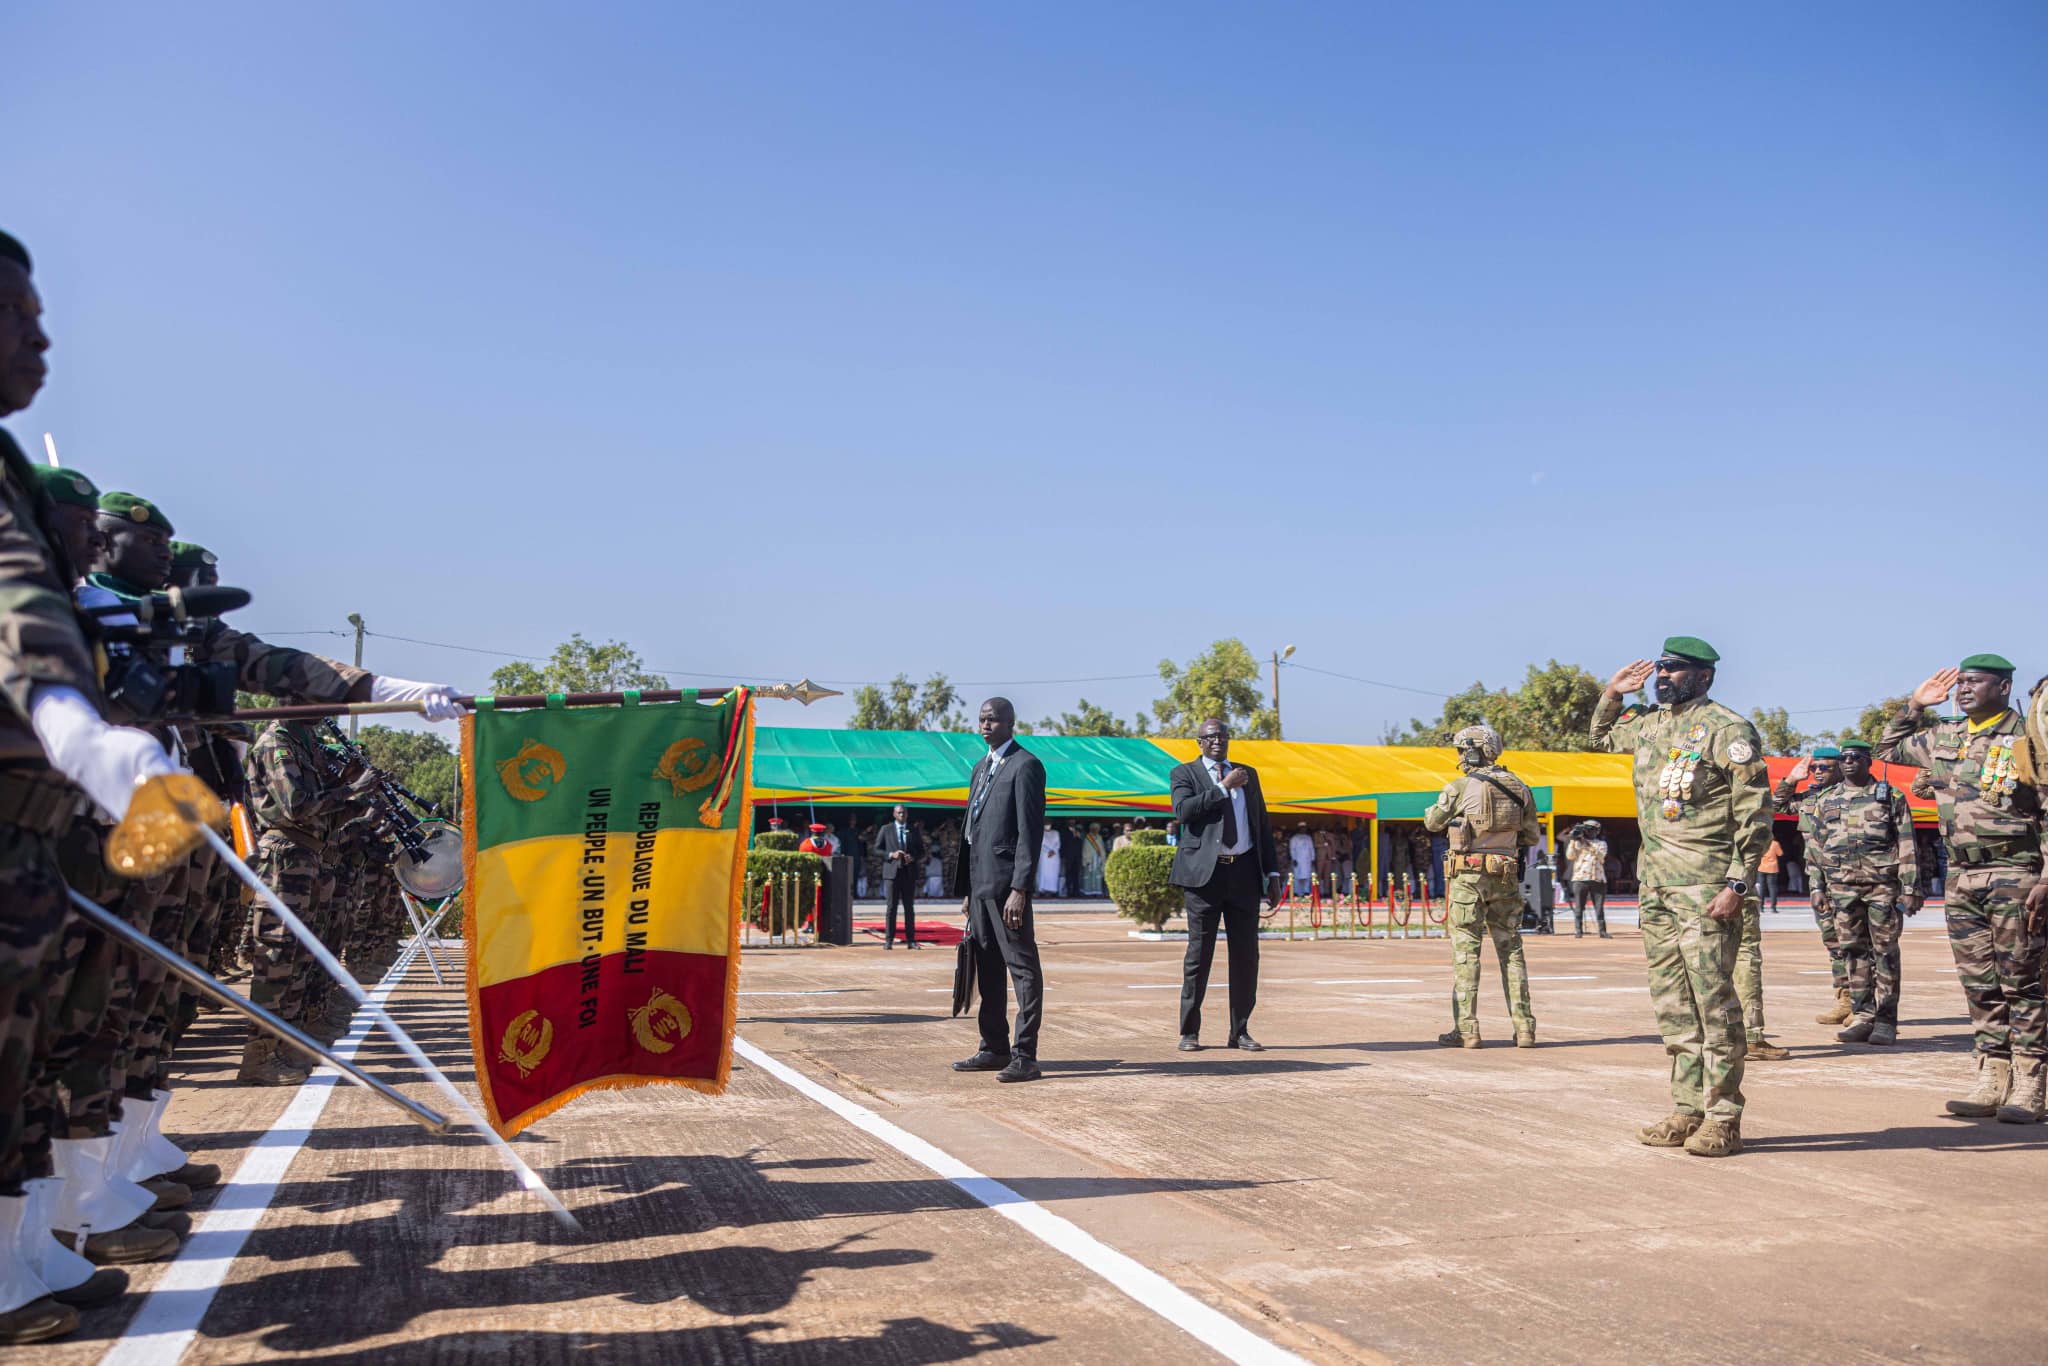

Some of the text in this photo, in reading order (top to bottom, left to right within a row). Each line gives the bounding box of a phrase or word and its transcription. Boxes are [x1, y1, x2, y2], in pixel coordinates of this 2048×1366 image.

[588, 788, 612, 808] UN
[583, 813, 608, 865] PEUPLE
[582, 876, 605, 901] UN
[623, 801, 661, 973] REPUBLIQUE DU MALI
[582, 908, 604, 942] BUT
[581, 953, 602, 994] UNE
[578, 998, 598, 1030] FOI
[652, 1014, 677, 1038] RM
[519, 1023, 540, 1048] RM
